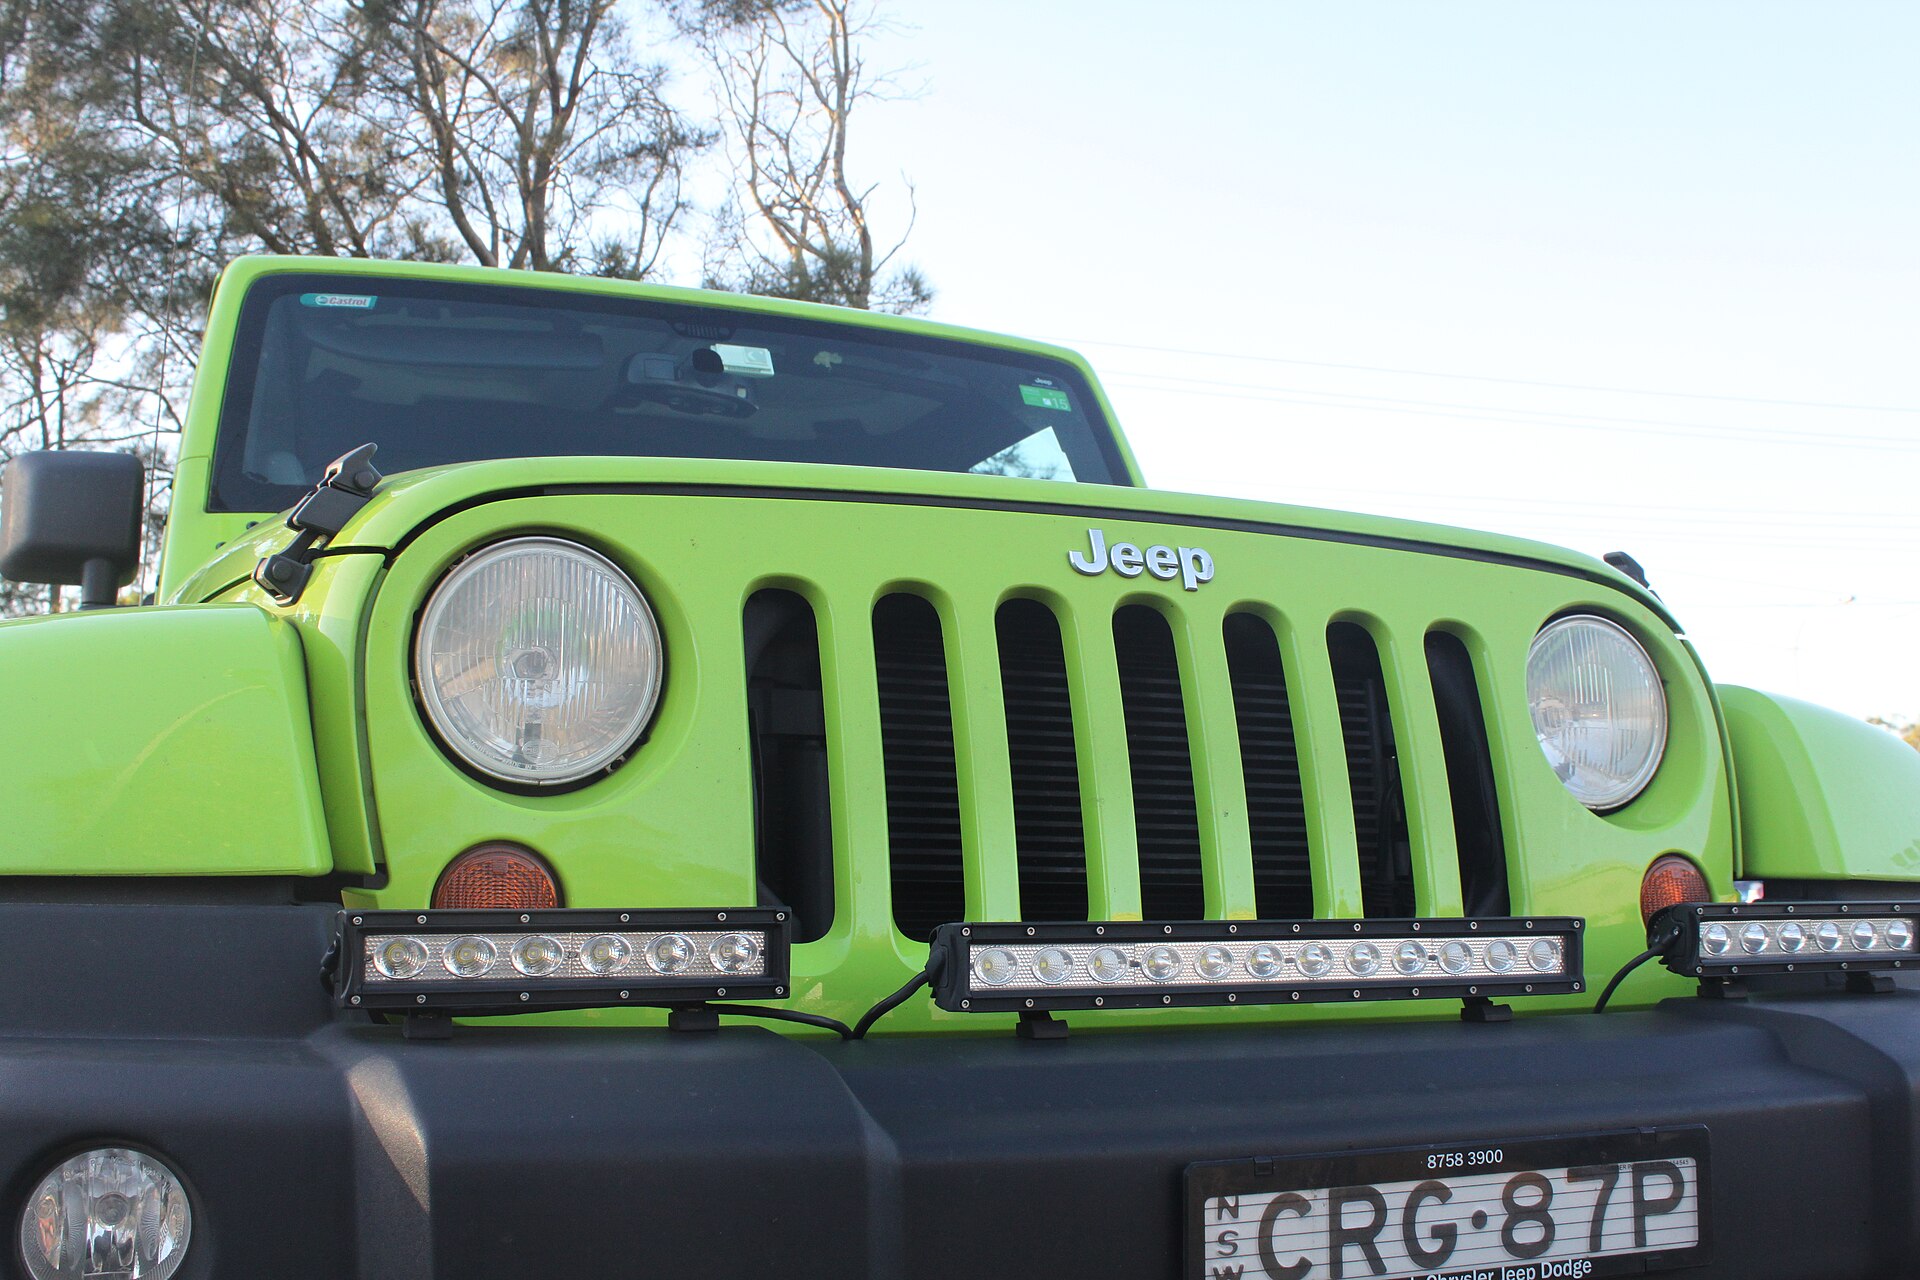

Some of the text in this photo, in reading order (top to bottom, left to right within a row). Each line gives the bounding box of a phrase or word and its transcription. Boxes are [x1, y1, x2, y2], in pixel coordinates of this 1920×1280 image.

[329, 296, 367, 306] Castrol
[1068, 528, 1215, 591] Jeep
[1427, 1149, 1503, 1169] 8758 3900
[1501, 1266, 1537, 1280] Jeep
[1541, 1259, 1592, 1279] Dodge
